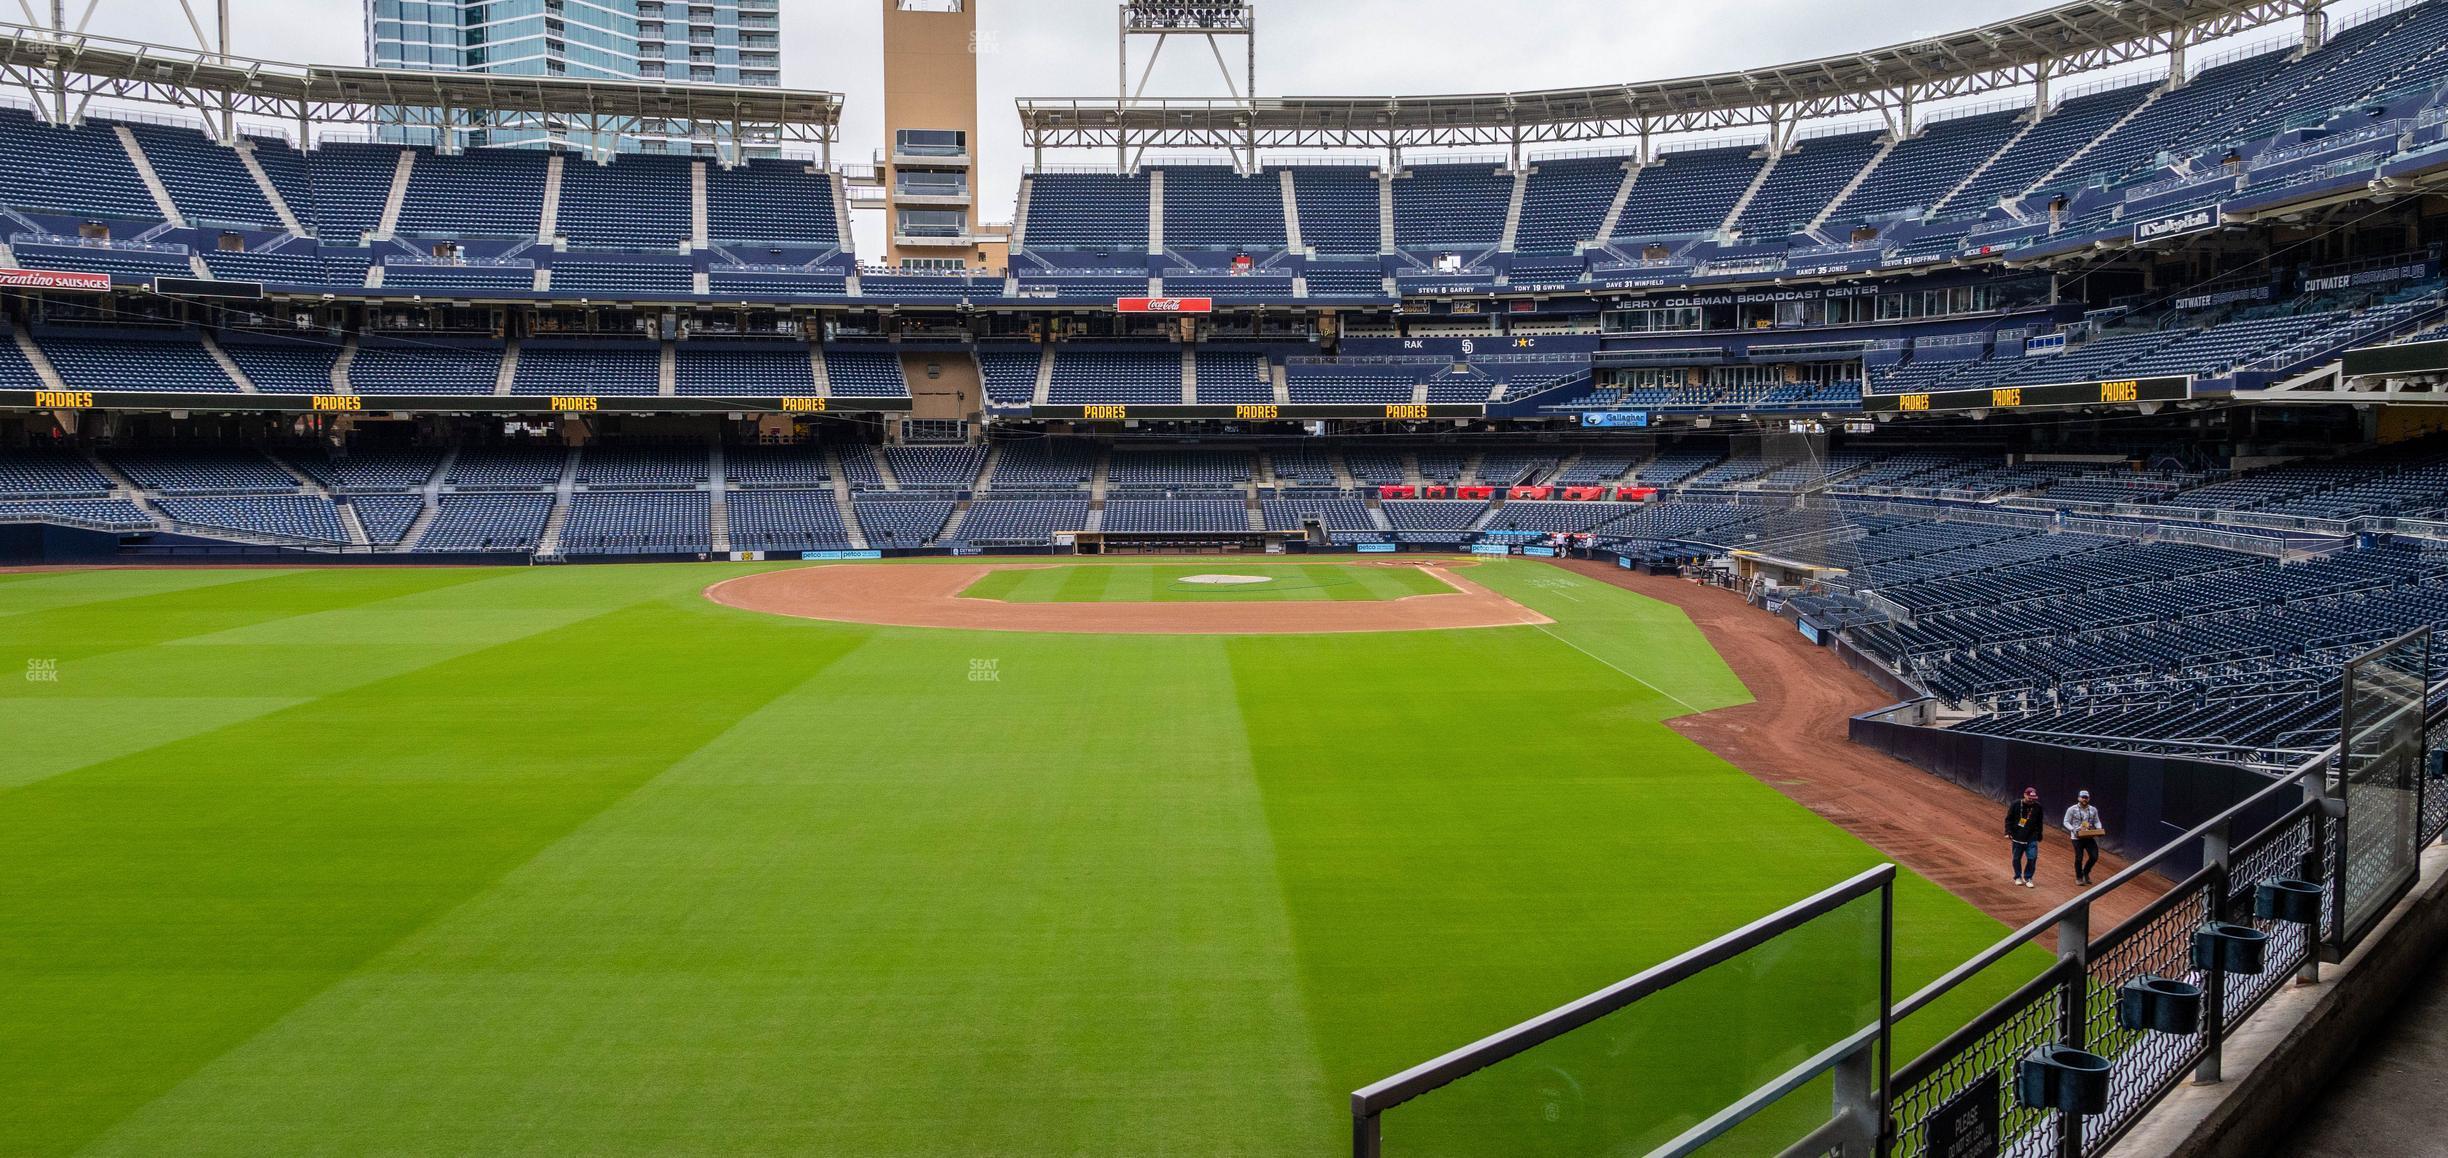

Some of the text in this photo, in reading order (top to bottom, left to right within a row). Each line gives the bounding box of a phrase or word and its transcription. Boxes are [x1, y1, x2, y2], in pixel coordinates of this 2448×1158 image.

[1881, 254, 1940, 267] TREVOR 51 HOFFMAN
[1796, 265, 1848, 275] RANDY 35 JONES
[0, 271, 109, 289] rantino SAUSAGES
[1624, 280, 1633, 288] 31
[1634, 279, 1664, 287] WINFIELD
[2304, 274, 2350, 292] CUTWATER
[1441, 286, 1447, 294] 6
[1532, 284, 1541, 292] 19
[1616, 284, 1879, 309] JERRY COLEMAN BROADCAST CENTER
[2175, 295, 2211, 309] CUTWATER
[1404, 340, 1423, 349] RAK
[1992, 389, 2020, 407] PADRES
[2101, 381, 2136, 402] PADRES
[36, 391, 93, 408] PADRES
[313, 396, 361, 410] PADRES
[551, 396, 598, 411] PADRES
[782, 397, 825, 411] PADRES
[1900, 394, 1929, 411] PADRES
[1084, 405, 1125, 419] PADRES
[1236, 405, 1277, 419] PADRES
[1386, 405, 1427, 418] PADRES
[1606, 413, 1645, 423] Gallagher
[1955, 1105, 1979, 1137] PLEASE
